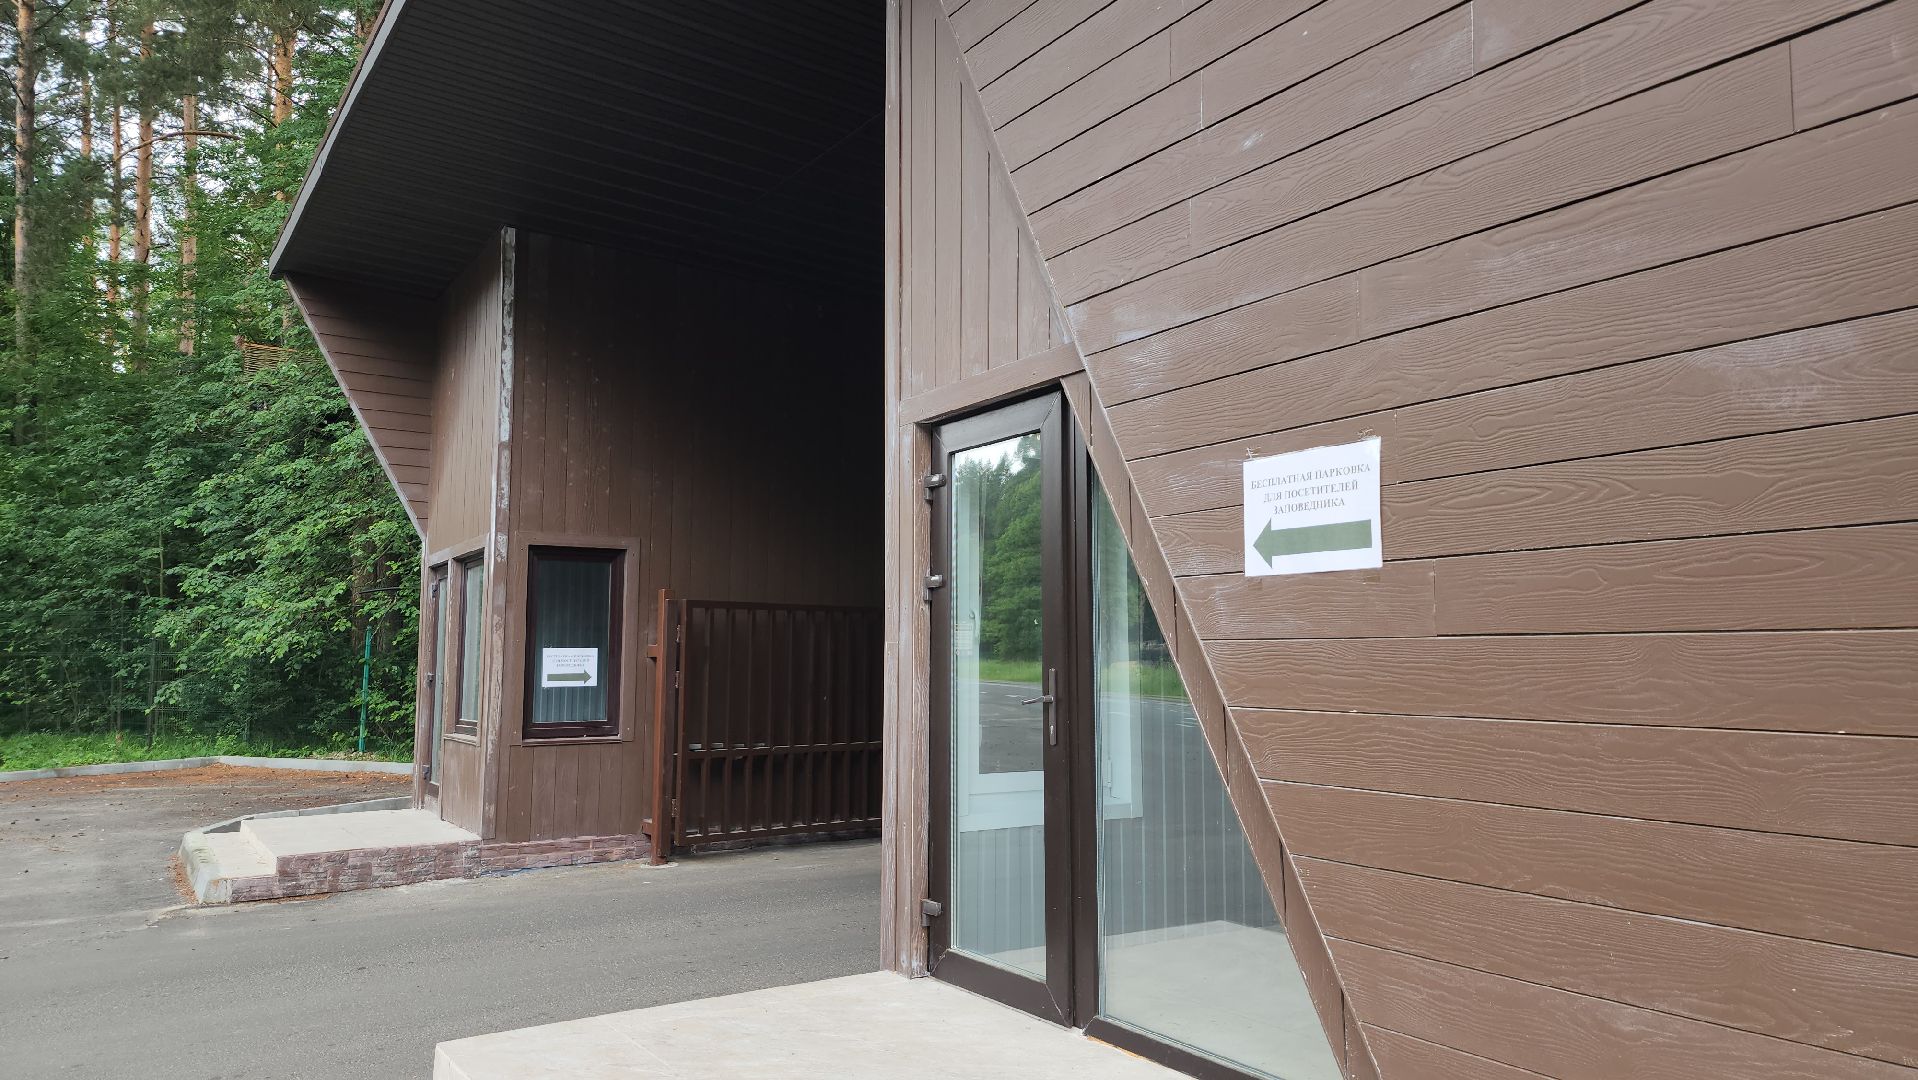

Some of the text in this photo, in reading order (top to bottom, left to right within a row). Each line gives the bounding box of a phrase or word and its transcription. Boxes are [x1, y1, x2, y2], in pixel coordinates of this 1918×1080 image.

[1251, 463, 1371, 489] БЕСПЛАТНАЯ ПАРКОВКА
[1263, 480, 1358, 503] ДЛЯ ПОСЕТИТЕЛЕЙ
[1274, 497, 1345, 514] ЗАПОВЕДНИКА
